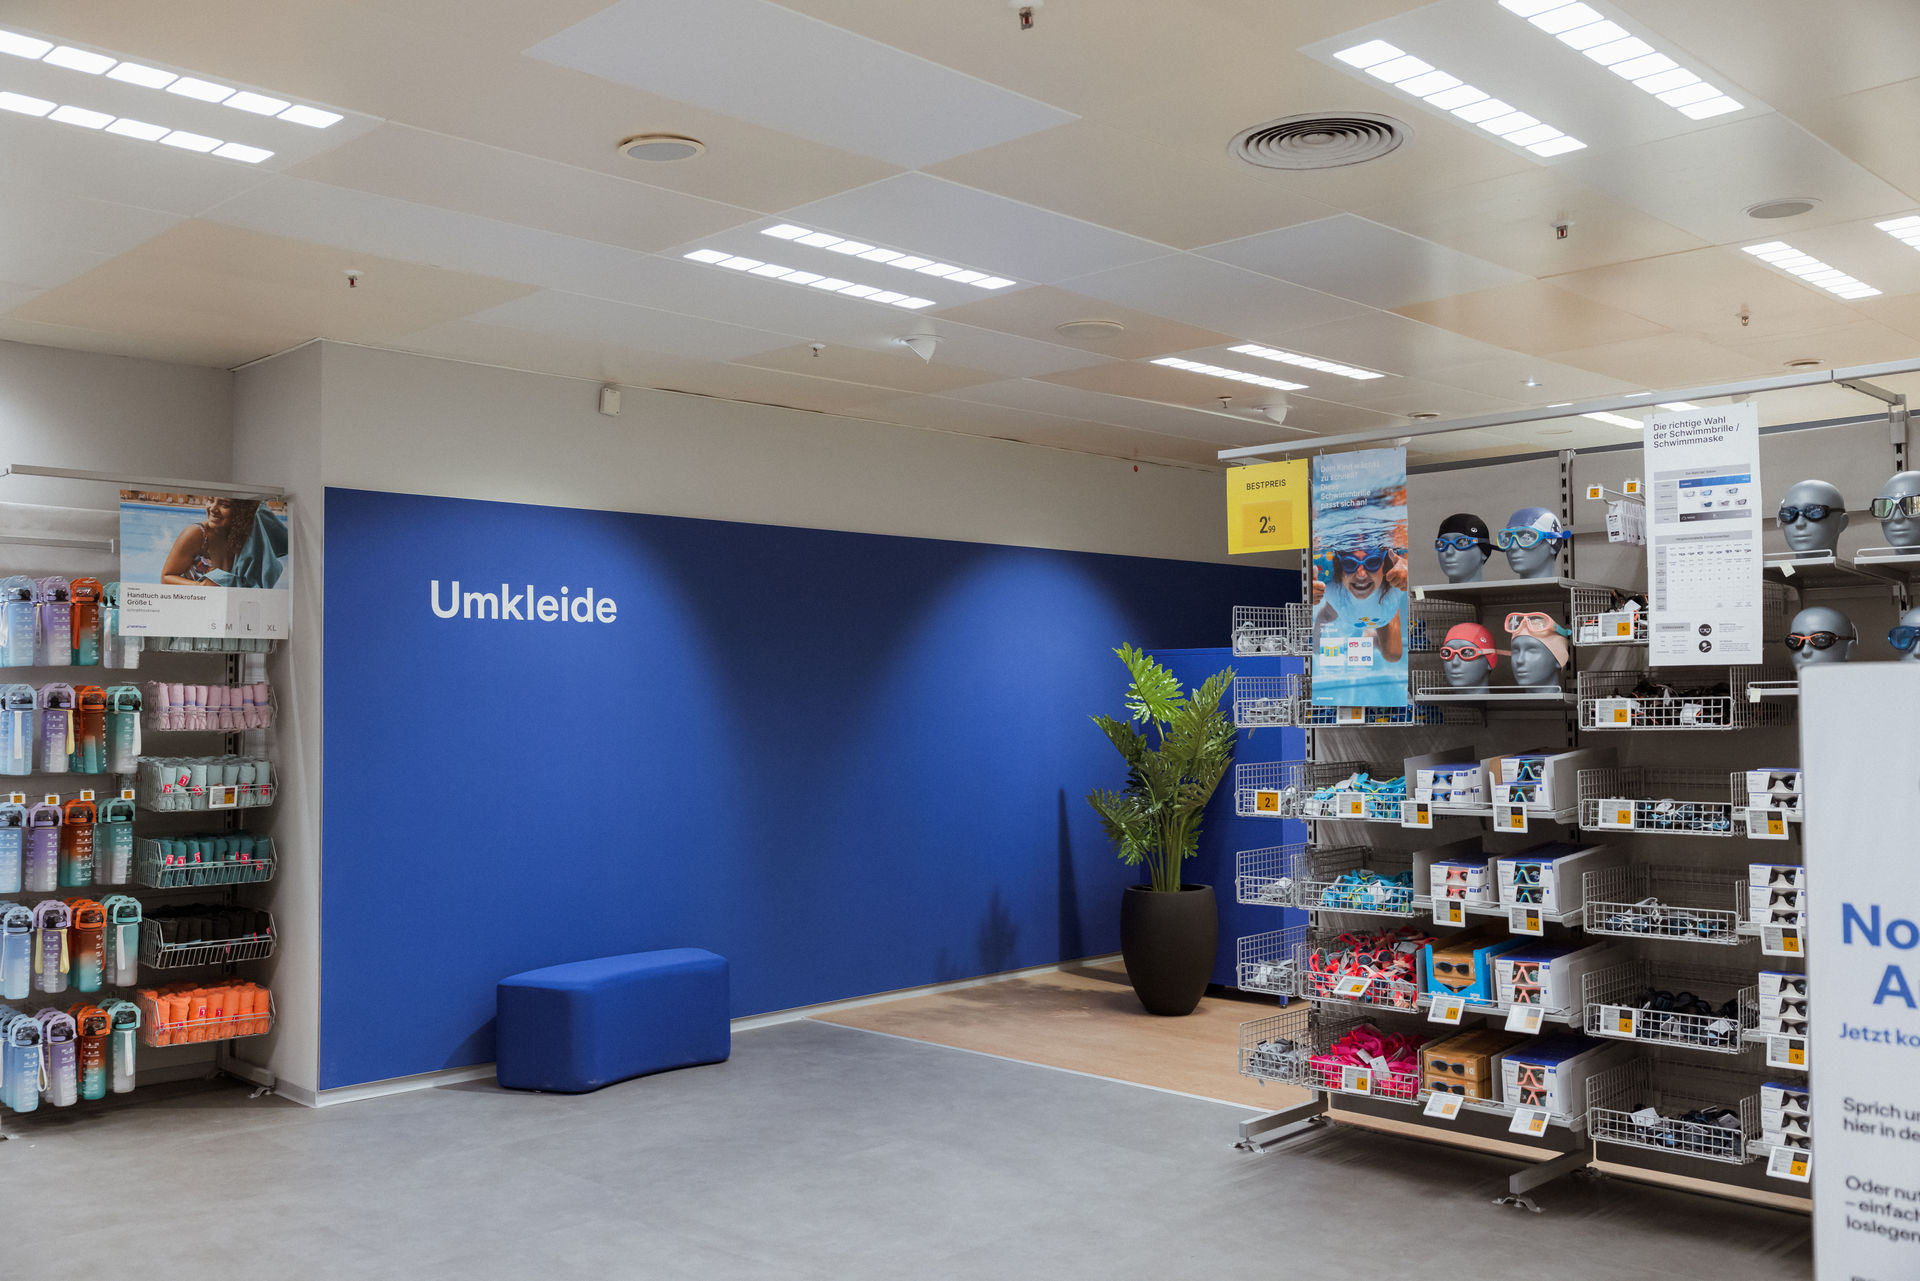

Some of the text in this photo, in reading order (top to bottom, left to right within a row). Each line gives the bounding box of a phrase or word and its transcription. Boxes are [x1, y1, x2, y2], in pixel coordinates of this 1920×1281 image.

[1653, 416, 1726, 431] Die richtige Wahl
[1653, 431, 1667, 440] der
[1669, 426, 1734, 438] Schwimmbrille
[1653, 435, 1724, 448] Schwimmmaske
[1246, 479, 1286, 490] BESTPREIS
[127, 591, 159, 599] Handtuch
[173, 593, 207, 601] Mikrofaser
[127, 598, 147, 606] Größe
[430, 580, 617, 623] Umkleide
[225, 623, 233, 631] M
[267, 624, 278, 632] XL
[1841, 902, 1920, 950] No
[1872, 964, 1920, 1009] A
[1839, 1022, 1920, 1048] Jetzt ko
[1843, 1096, 1901, 1119] Sprich
[1843, 1117, 1876, 1134] hier
[1880, 1122, 1895, 1138] in
[1845, 1176, 1889, 1196] Oder
